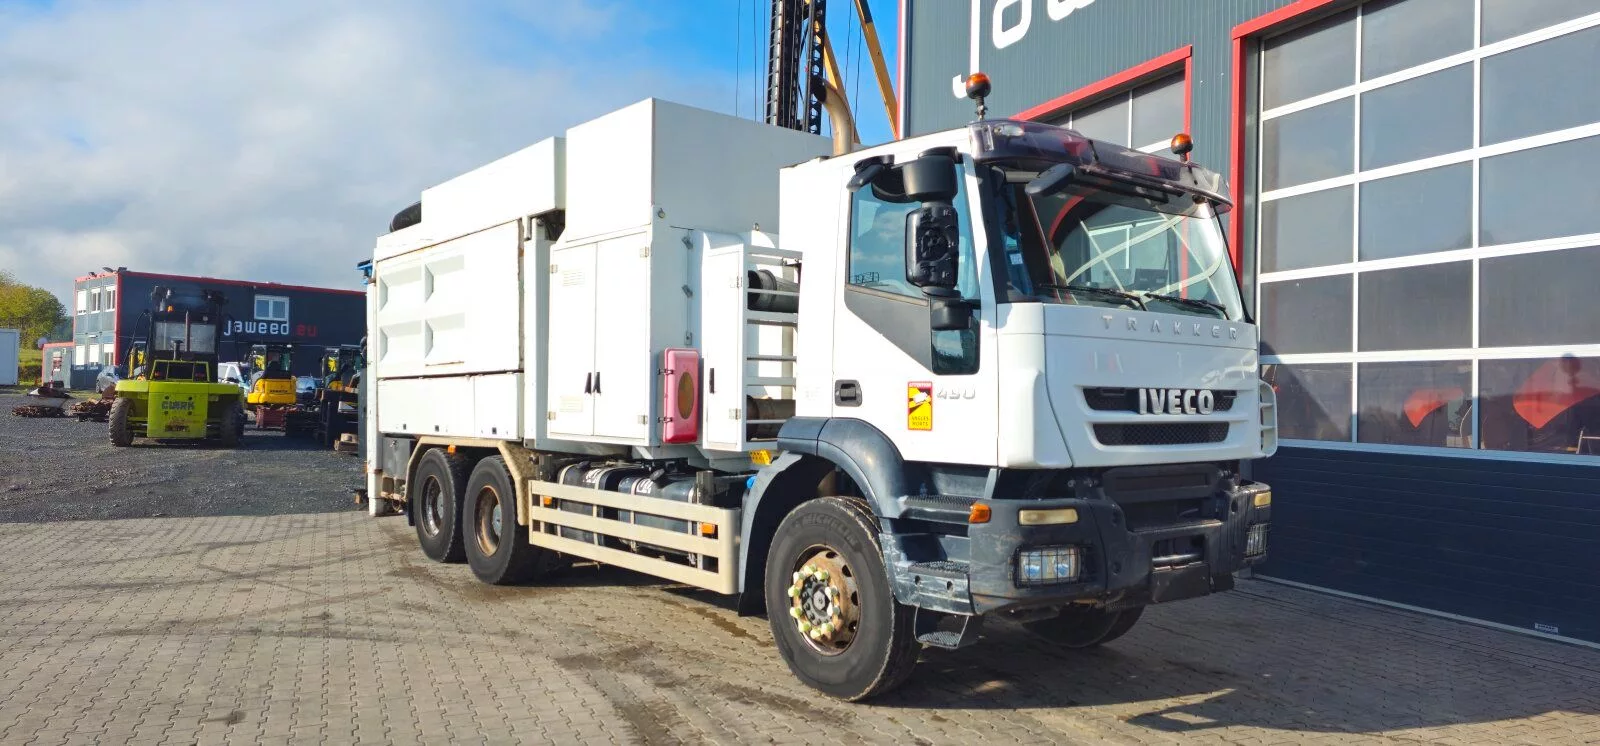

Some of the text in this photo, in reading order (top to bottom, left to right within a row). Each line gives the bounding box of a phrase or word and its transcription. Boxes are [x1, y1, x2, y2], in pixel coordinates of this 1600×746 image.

[952, 0, 1095, 99] ja
[223, 320, 289, 336] jaweed
[1102, 315, 1237, 340] TRAKKER
[1139, 388, 1215, 416] IVECO
